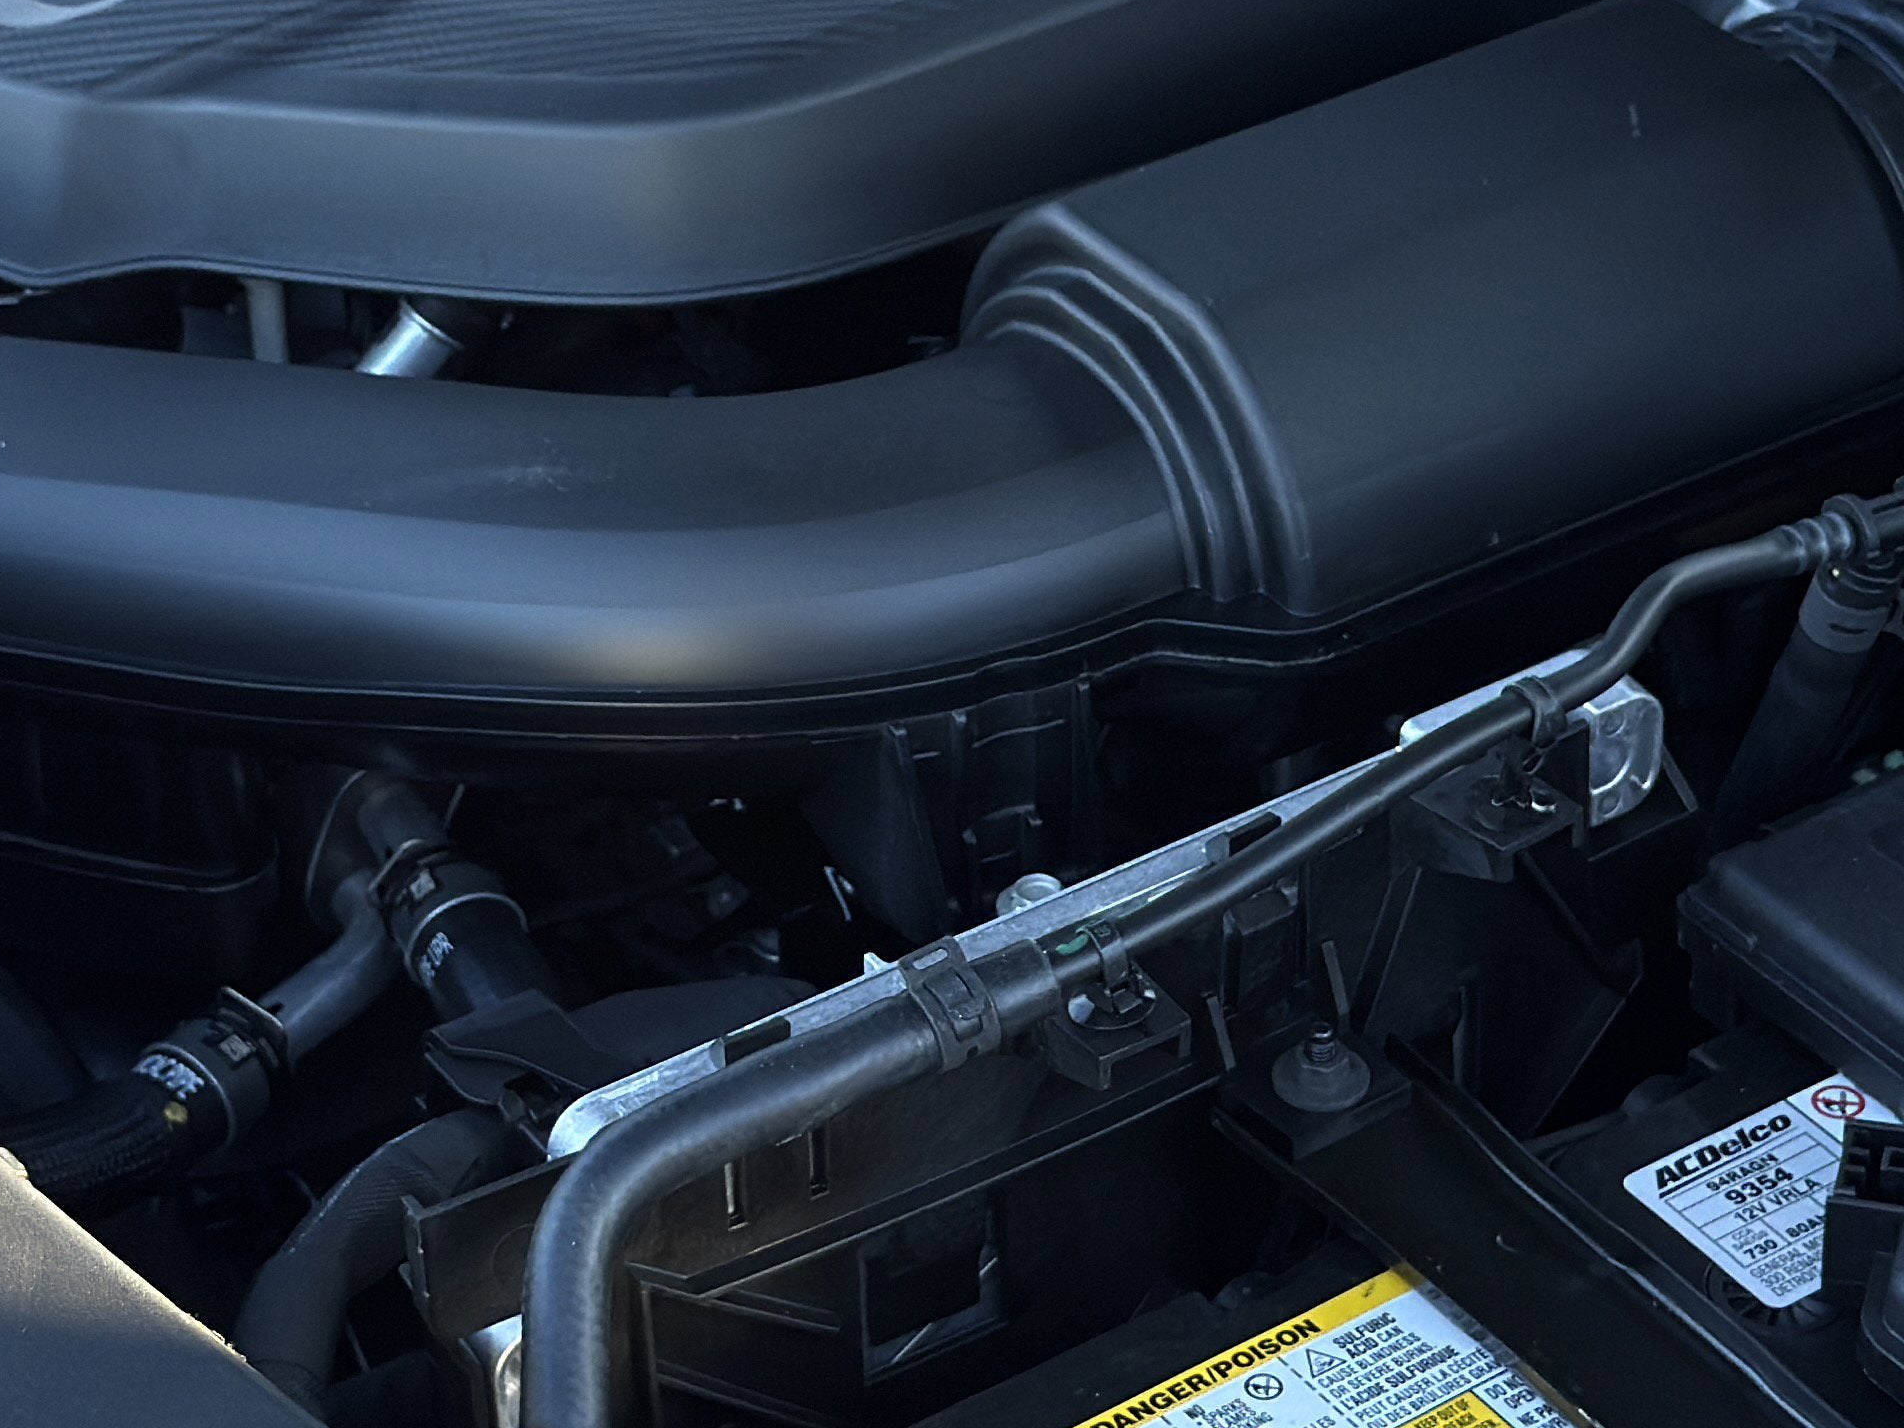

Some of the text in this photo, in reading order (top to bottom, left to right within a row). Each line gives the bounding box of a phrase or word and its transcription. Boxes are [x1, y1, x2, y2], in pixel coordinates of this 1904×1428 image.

[1655, 1114, 1792, 1190] ACDelco
[1724, 1167, 1794, 1205] 9354
[1734, 1177, 1823, 1223] 12V VRLA
[1743, 1239, 1778, 1260] 730
[1750, 1248, 1807, 1278] GENERAL
[1760, 1271, 1786, 1288] 300
[1332, 1311, 1397, 1349] SULFURIC
[1345, 1325, 1405, 1360] ACID CAN
[1317, 1331, 1422, 1389] CAUSE BLINDNESS
[1328, 1341, 1437, 1400] OR SEVERE BURNS.
[1339, 1344, 1461, 1411] L'ACIDE SULFURIQUE
[1354, 1344, 1491, 1423] PEUT CAUSER LA CÉCITÉ
[1483, 1383, 1508, 1400] DO
[1184, 1404, 1206, 1420] NO
[1201, 1397, 1247, 1425] SPARKS
[1384, 1405, 1413, 1424] DES
[1436, 1404, 1459, 1421] OUT
[1454, 1398, 1470, 1412] OF
[1516, 1411, 1540, 1427] NE
